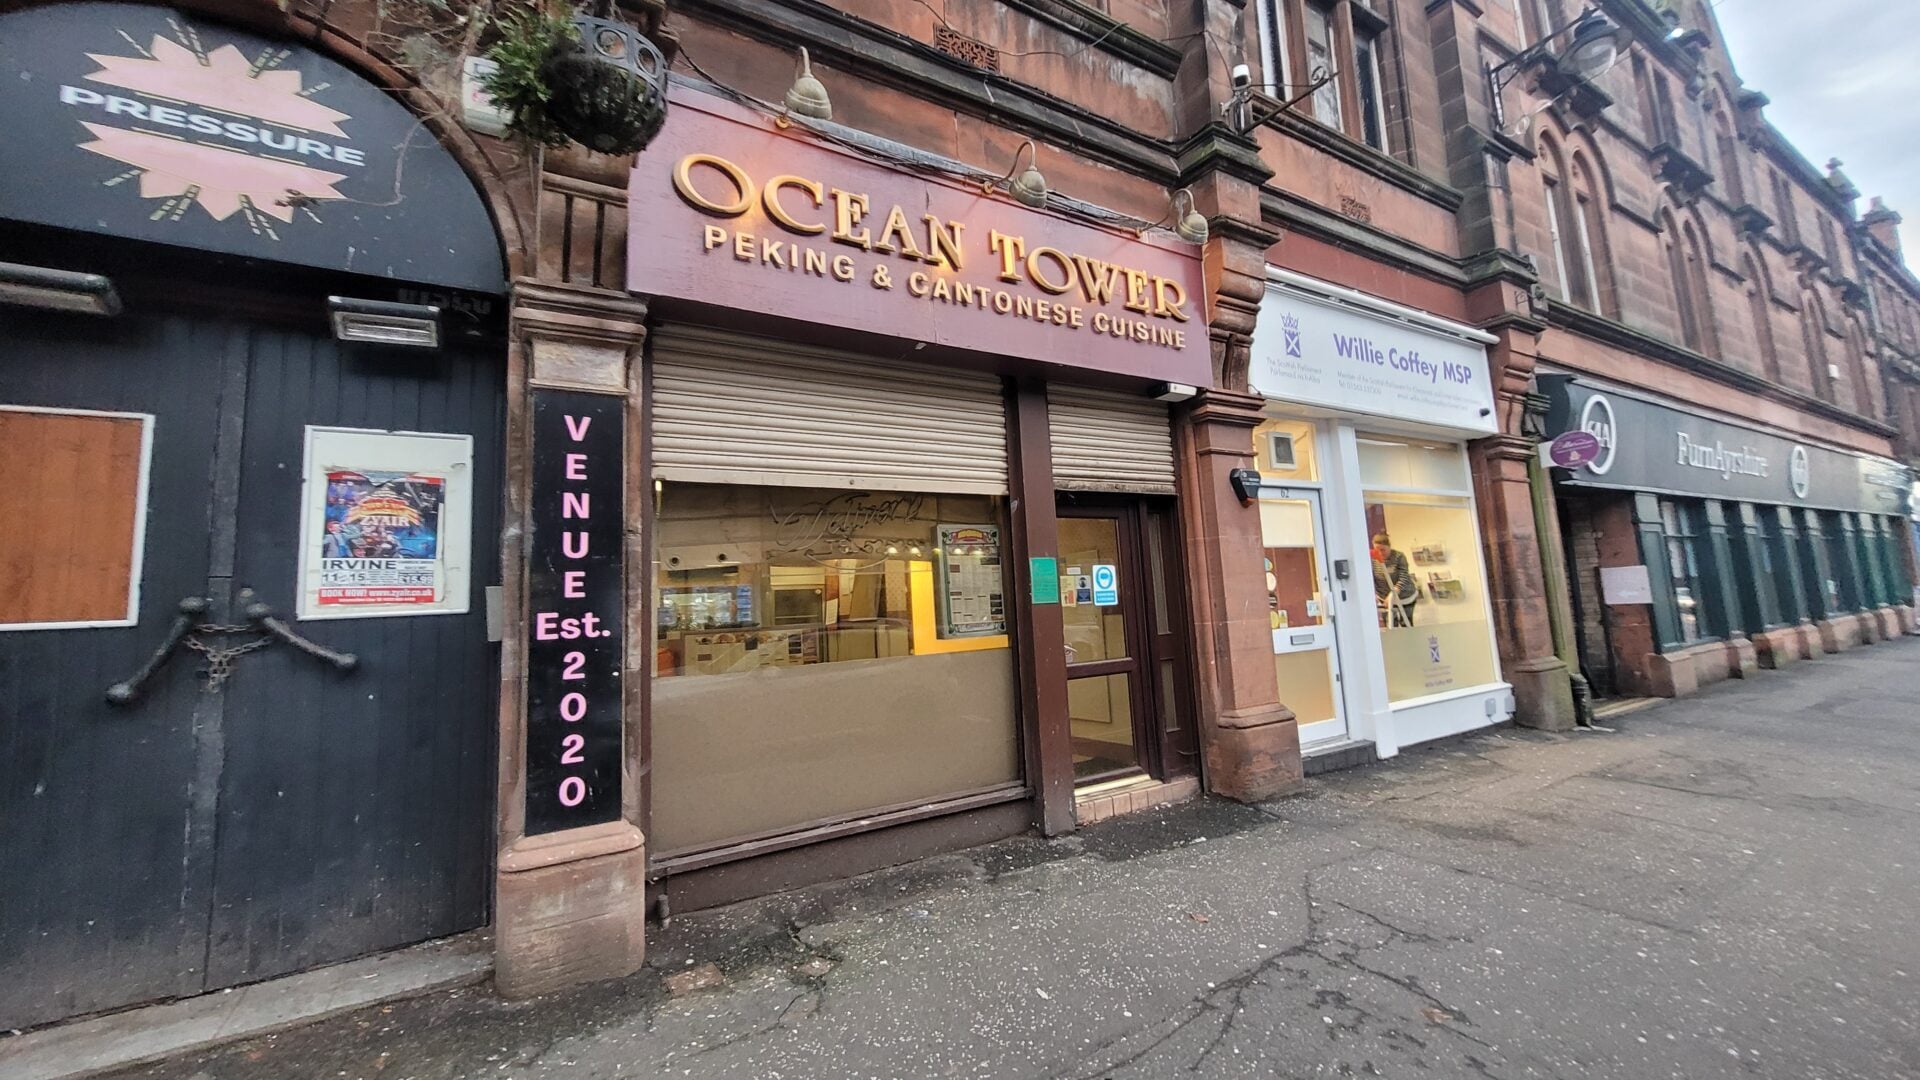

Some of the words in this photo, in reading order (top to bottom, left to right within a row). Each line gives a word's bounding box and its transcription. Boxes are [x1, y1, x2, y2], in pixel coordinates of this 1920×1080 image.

[60, 84, 366, 167] PRESSURE
[672, 152, 965, 271] OCEAN
[990, 228, 1191, 322] TOWER
[704, 223, 856, 283] PEKING
[872, 264, 894, 290] &
[910, 270, 1084, 329] CANTONESE
[1094, 311, 1187, 350] CUISINE
[1333, 333, 1385, 366] Willie
[1388, 347, 1438, 384] Coffey
[1443, 360, 1472, 385] MSP
[1676, 431, 1769, 480] FurnAyrshire
[562, 414, 592, 599] VENUE
[322, 559, 398, 570] IRVINE
[322, 572, 339, 581] 11
[349, 573, 366, 582] 15
[536, 612, 611, 640] Est.
[558, 651, 588, 807] 2020
